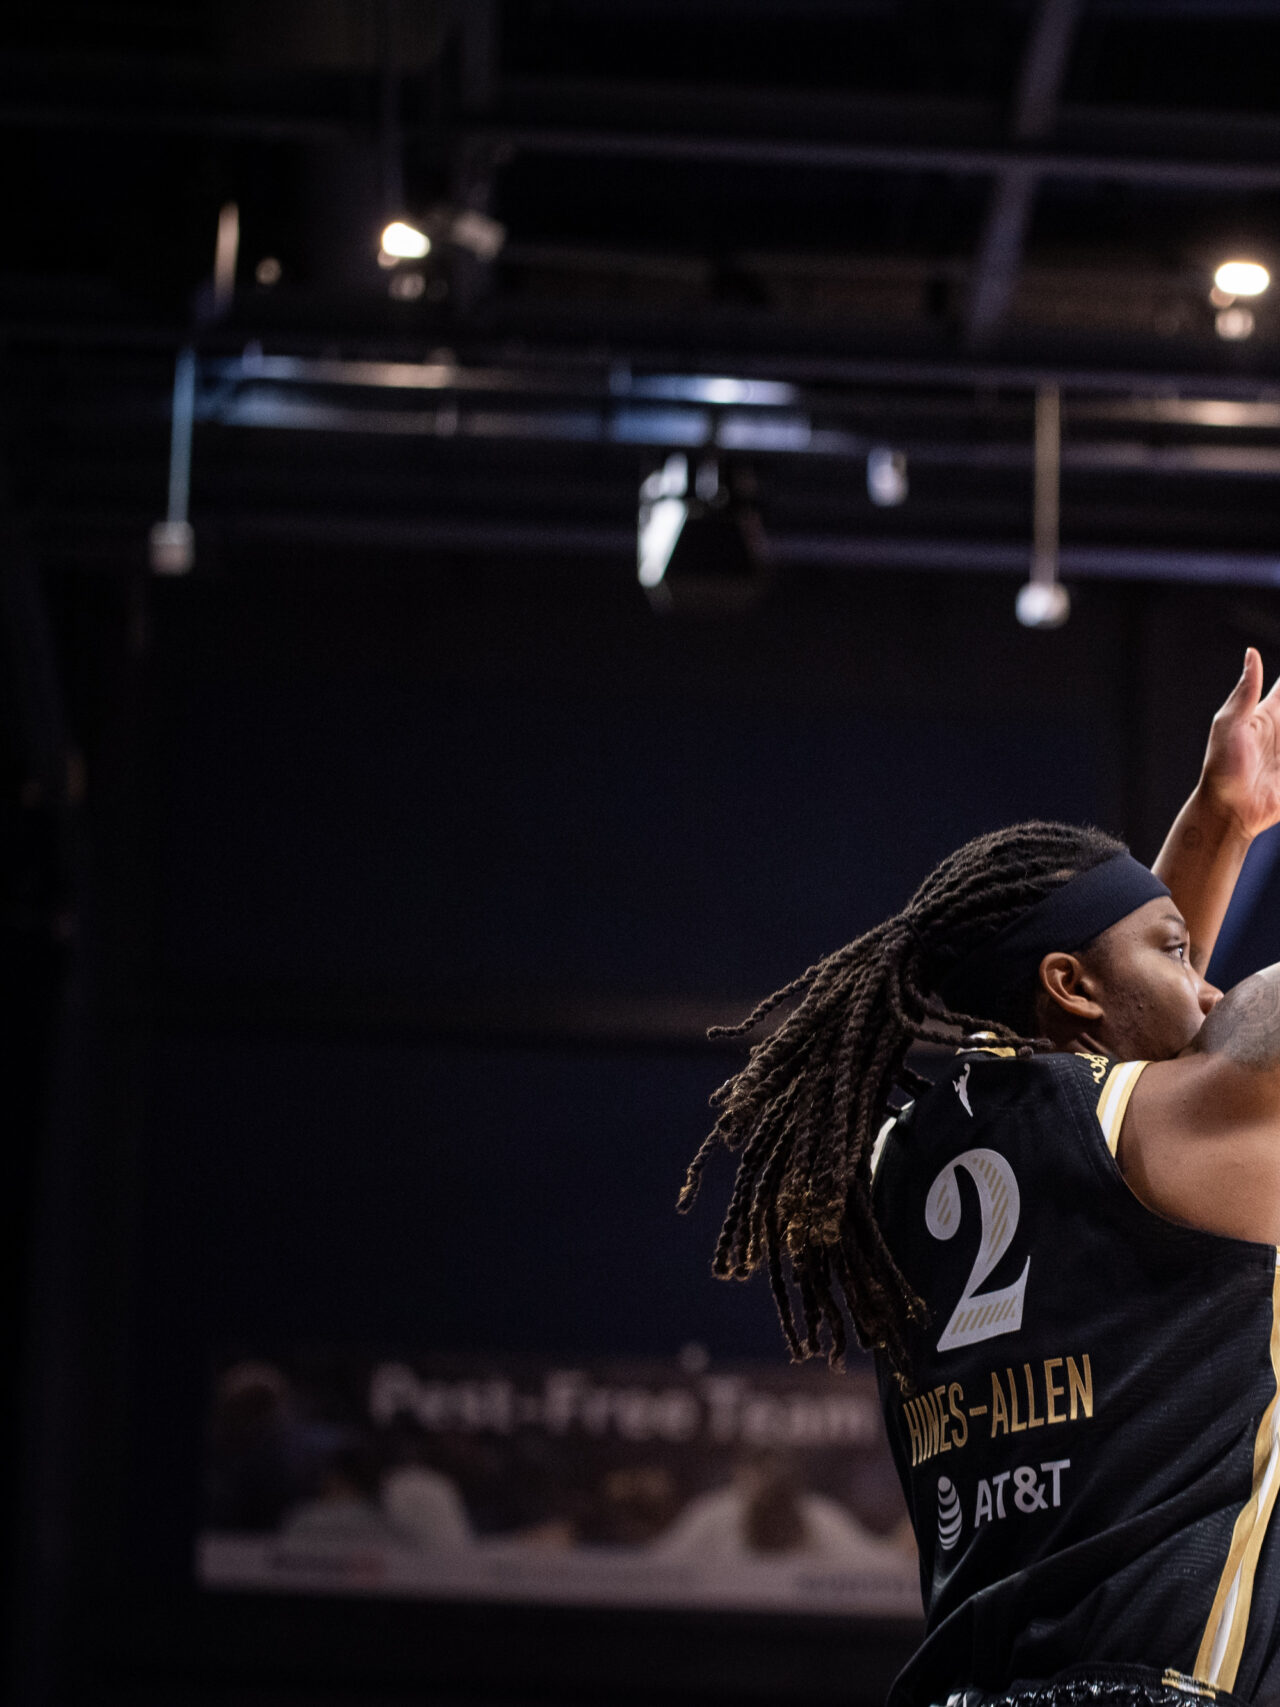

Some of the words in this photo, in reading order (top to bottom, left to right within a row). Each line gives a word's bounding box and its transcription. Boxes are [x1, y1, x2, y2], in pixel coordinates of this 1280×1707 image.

[924, 1147, 1031, 1352] 2
[903, 1354, 1094, 1467] HINES-ALLEN
[974, 1458, 1071, 1528] AT&T
